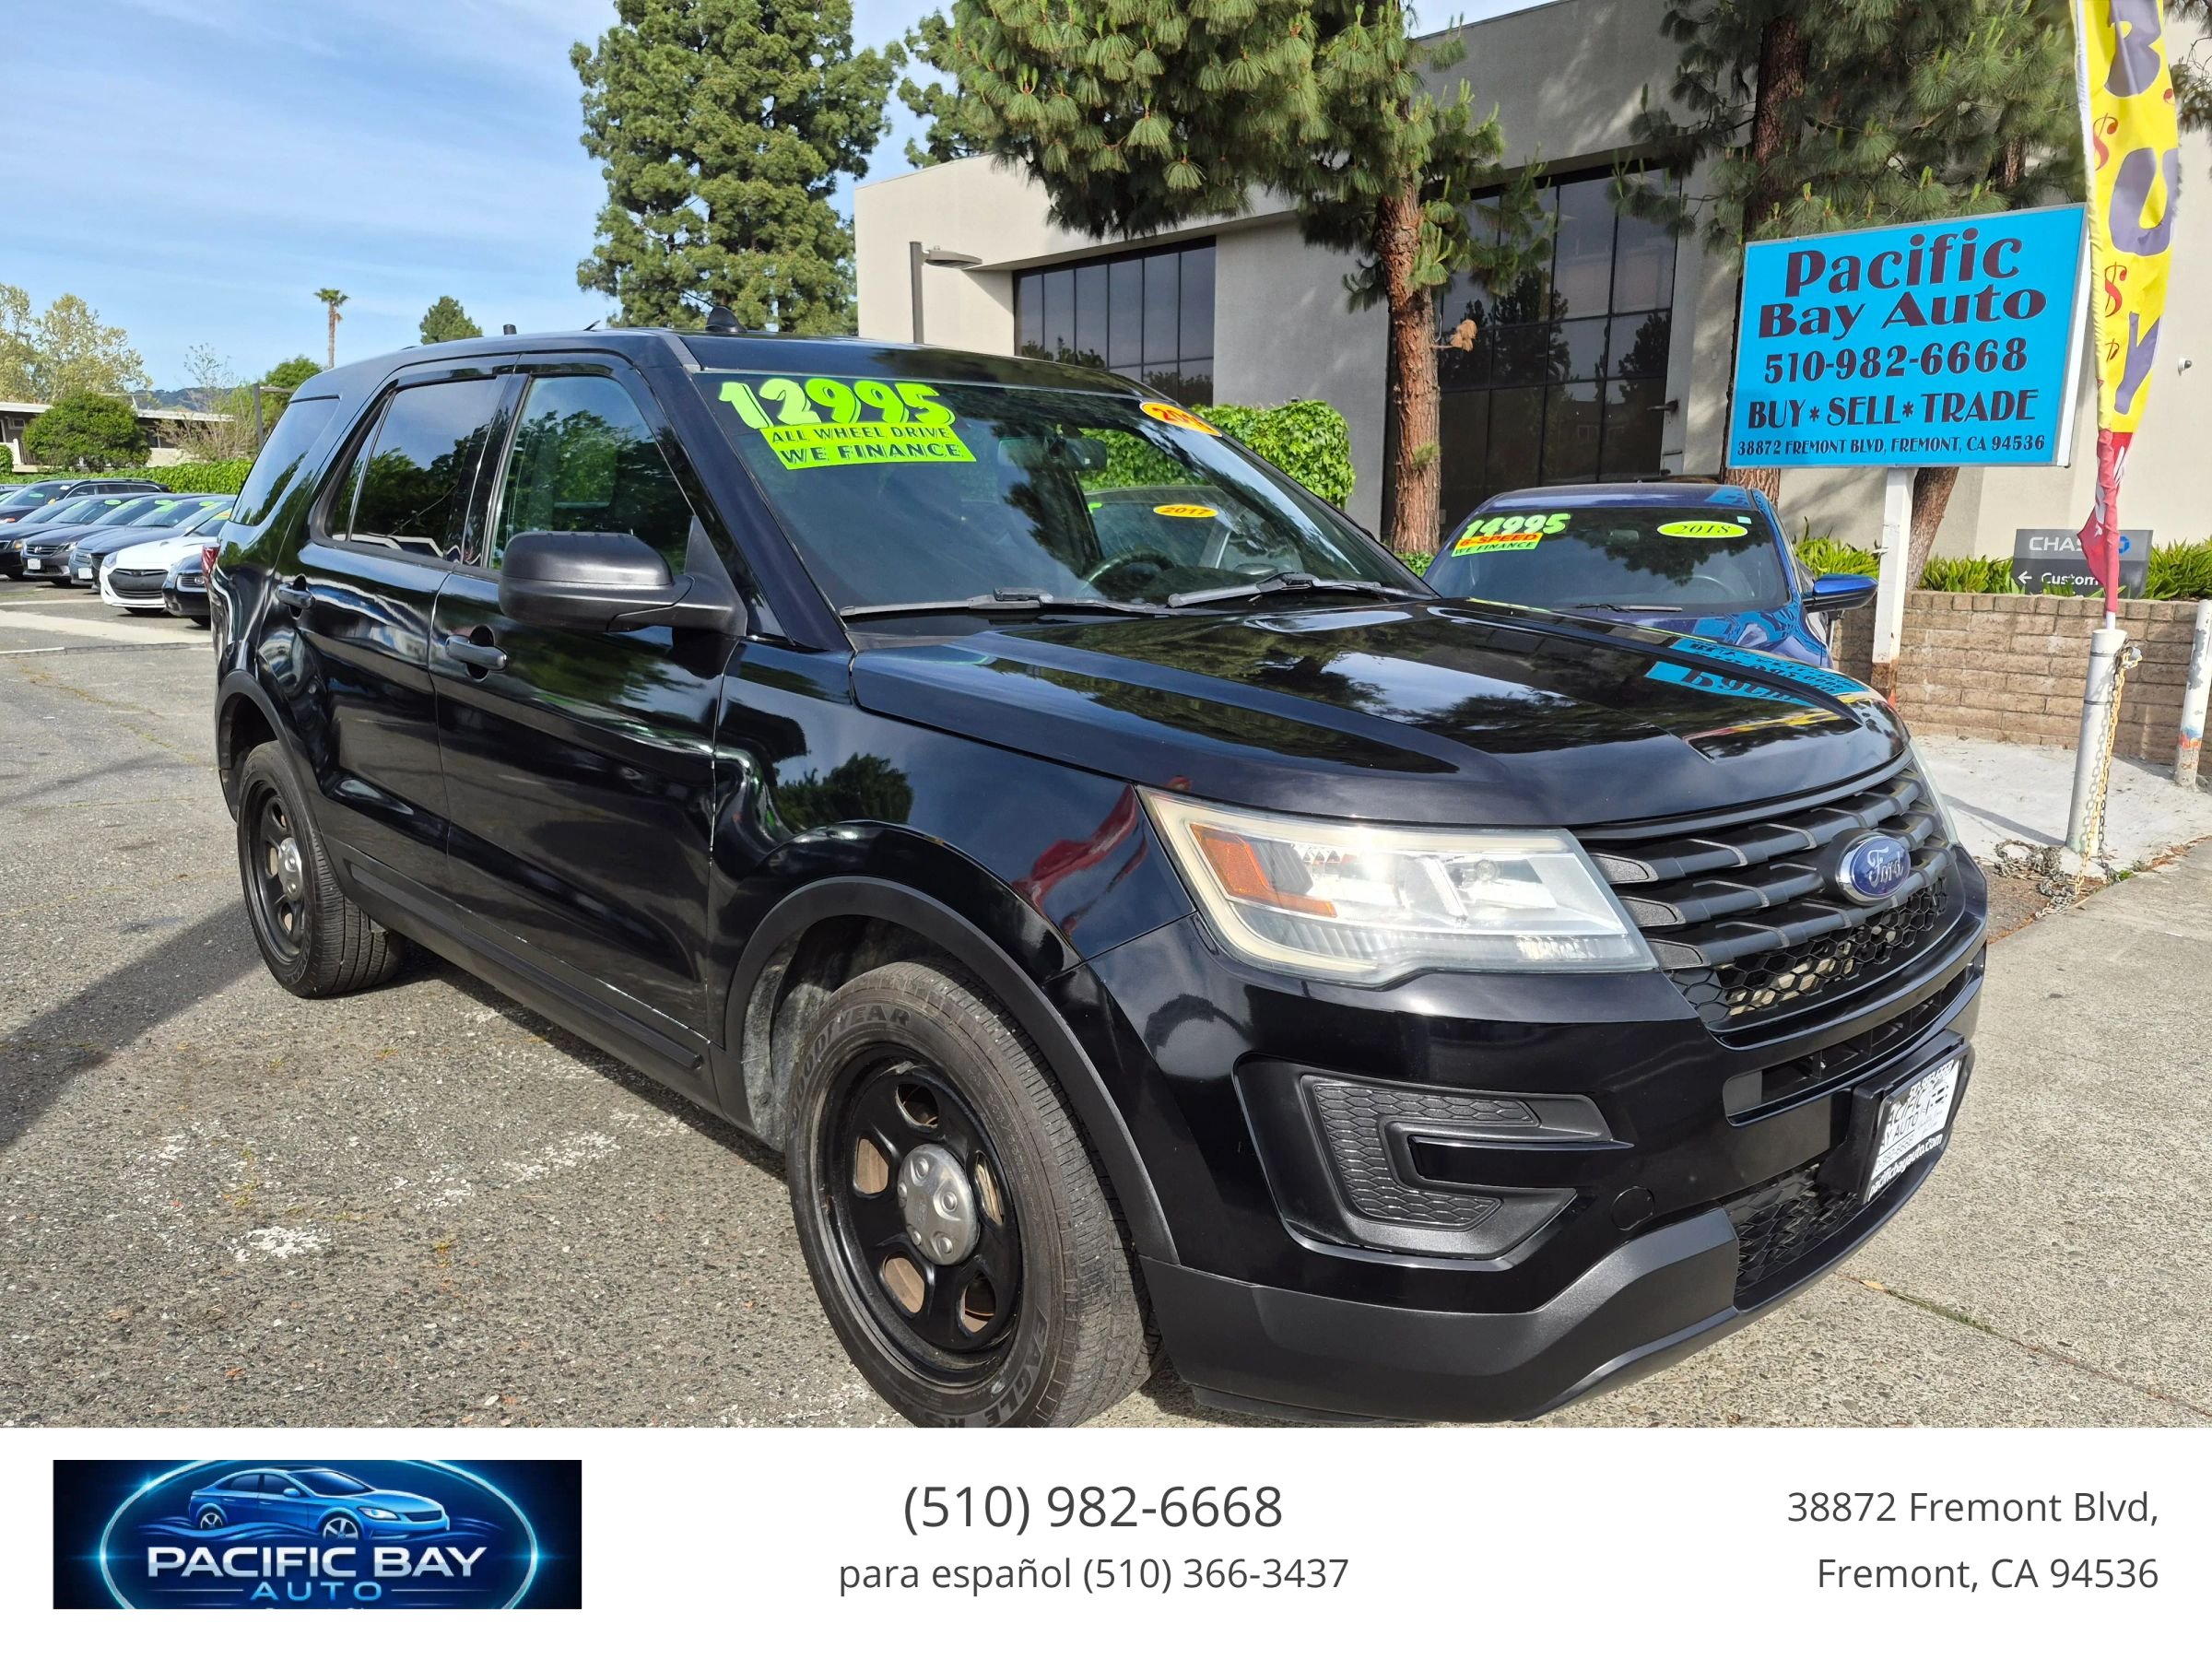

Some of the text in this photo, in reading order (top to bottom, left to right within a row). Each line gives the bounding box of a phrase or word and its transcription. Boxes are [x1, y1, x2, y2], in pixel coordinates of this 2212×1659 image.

[1785, 228, 2022, 298] Pacific
[1759, 284, 2046, 341] Bay Auto
[1764, 337, 2028, 383] 510-982-6668
[718, 378, 956, 429] 12995
[1748, 389, 2039, 429] BUY SELL TRADE
[771, 426, 950, 443] ALL WHEEL DRIVE
[1737, 434, 2045, 456] 38872 FREMONT BLVD, FREMONT, CA 94536
[780, 443, 963, 464] WE FINANCE
[1163, 506, 1212, 516] 2017
[1461, 512, 1571, 540] 14995
[1674, 524, 1731, 535] 2018
[1460, 534, 1538, 547] 6-SPEED
[1475, 541, 1535, 551] FINANCE
[2029, 536, 2082, 552] CHA
[2041, 571, 2099, 586] Custom
[1866, 846, 1904, 888] Ford
